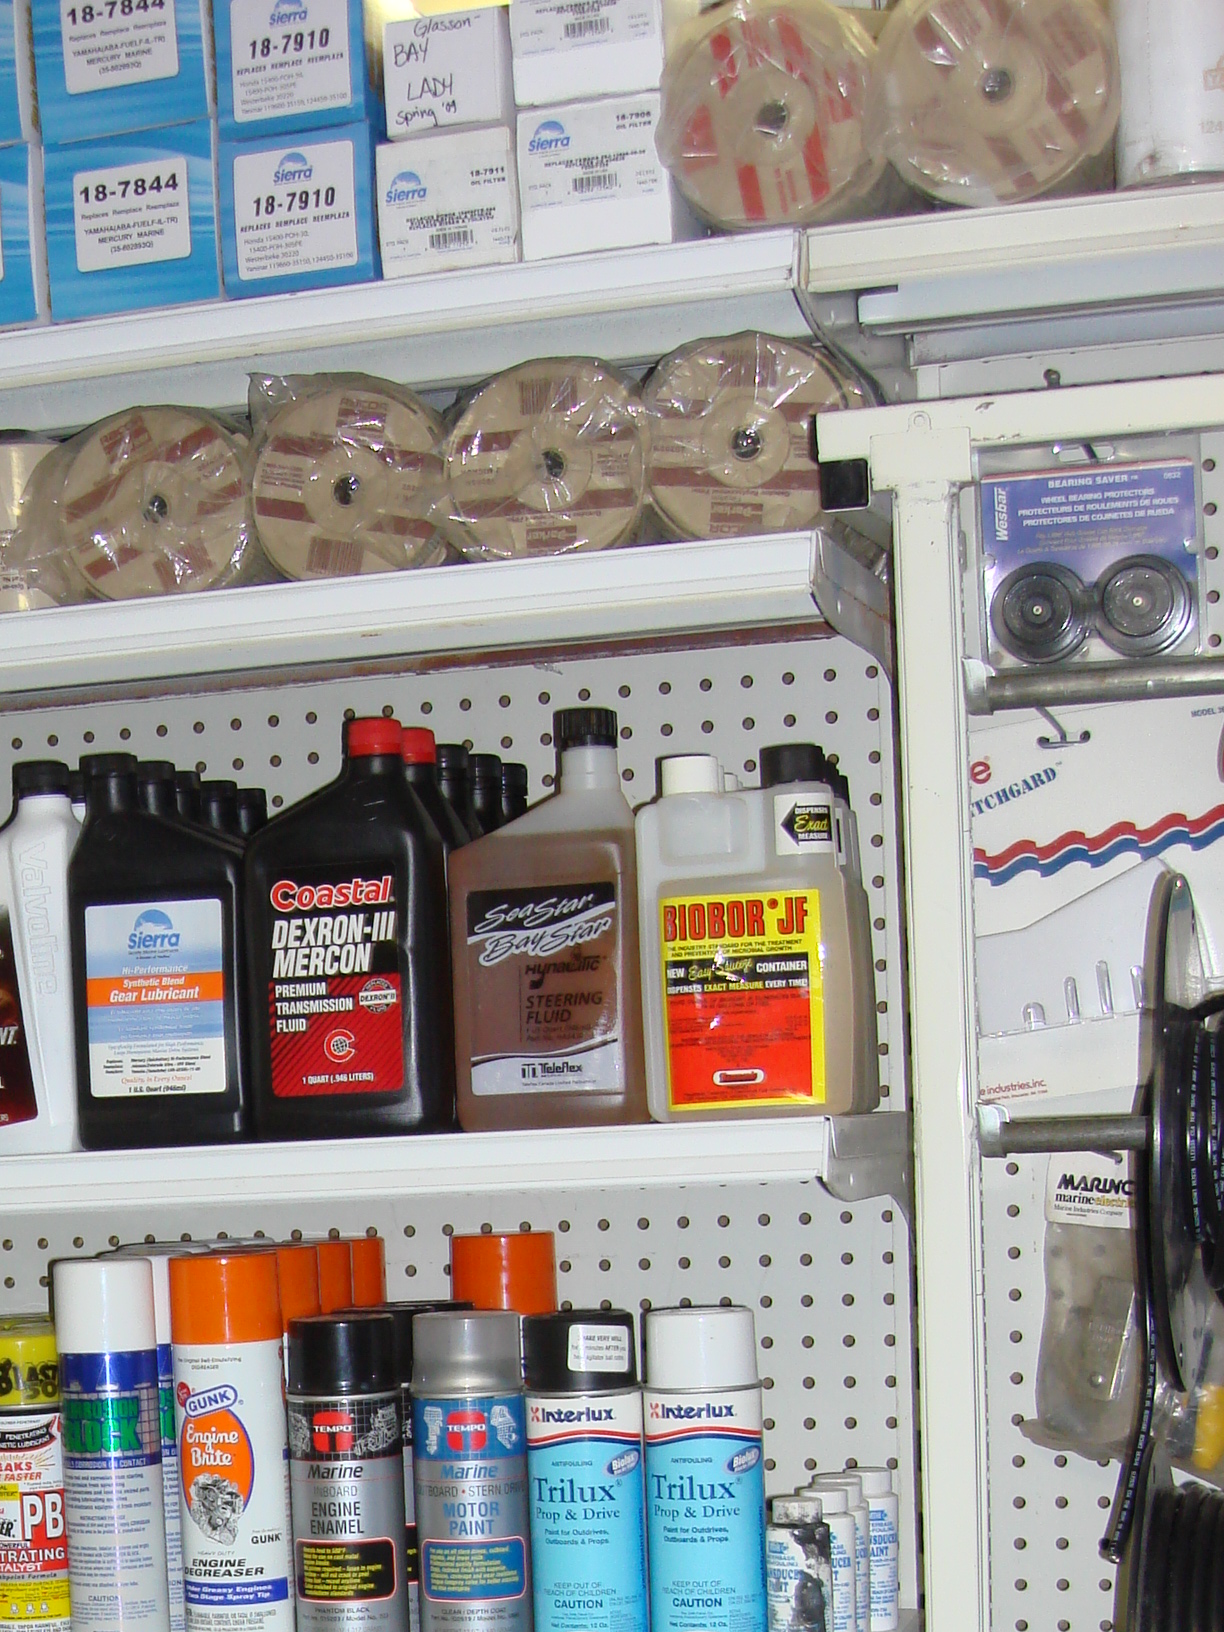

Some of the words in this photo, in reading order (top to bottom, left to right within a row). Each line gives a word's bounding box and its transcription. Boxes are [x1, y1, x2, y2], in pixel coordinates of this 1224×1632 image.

[67, 0, 166, 26] 18-7844
[249, 28, 330, 60] 18-7910
[393, 38, 429, 67] BAY
[407, 73, 453, 101] LADY
[528, 135, 570, 152] Sierra
[79, 173, 179, 203] 18-7844
[252, 187, 336, 217] 18-7910
[1048, 479, 1092, 489] BEARING
[1095, 475, 1129, 486] SAVER
[1041, 495, 1066, 504] WHEEL
[1068, 491, 1101, 502] BEARING
[1103, 488, 1155, 499] PROTECTORS
[995, 487, 1008, 542] Wesbar
[270, 876, 392, 913] Coastal
[664, 900, 765, 943] BIOBOR
[777, 896, 808, 934] JF
[272, 911, 395, 949] DEXRON-III
[127, 931, 180, 951] Sierra
[273, 943, 372, 978] MERCON
[667, 967, 684, 980] NEW
[756, 960, 807, 973] CONTAINER
[123, 976, 159, 988] Synthetic
[162, 975, 185, 986] Blend
[276, 982, 326, 998] PREMIUM
[704, 982, 726, 992] EXACT
[728, 981, 763, 991] MEASURE
[765, 979, 784, 989] EVERY
[787, 977, 808, 987] TIME!
[109, 989, 137, 1003] Gear
[140, 986, 200, 1001] Lubricant
[526, 992, 603, 1009] STEERING
[276, 997, 353, 1015] TRANSMISSION
[526, 1009, 571, 1024] FLUID
[276, 1018, 306, 1033] FLUID
[539, 1062, 582, 1077] Teleflex
[189, 1390, 230, 1412] GUNK
[541, 1406, 614, 1423] Interlux
[661, 1403, 734, 1419] Interlux
[313, 1424, 352, 1433] TEMPO
[447, 1423, 486, 1432] TEMPO
[186, 1424, 238, 1450] Engine
[192, 1447, 232, 1467] Brite
[314, 1485, 357, 1497] INBOARD
[533, 1476, 616, 1503] Trilux
[652, 1475, 736, 1500] Trilux
[26, 1493, 64, 1540] PB
[311, 1501, 361, 1517] ENGINE
[443, 1502, 499, 1517] MOTOR
[536, 1507, 562, 1524] Prop
[565, 1507, 578, 1521] &
[582, 1506, 620, 1521] Drive
[654, 1505, 679, 1523] Prop
[684, 1506, 696, 1520] &
[700, 1504, 740, 1519] Drive
[310, 1518, 364, 1535] ENAMEL
[449, 1520, 494, 1535] PAINT
[251, 1534, 281, 1545] GUNK
[193, 1558, 247, 1568] ENGINE
[184, 1567, 264, 1578] DEGREASER
[554, 1599, 603, 1609] CAUTION
[672, 1598, 722, 1608] CAUTION
